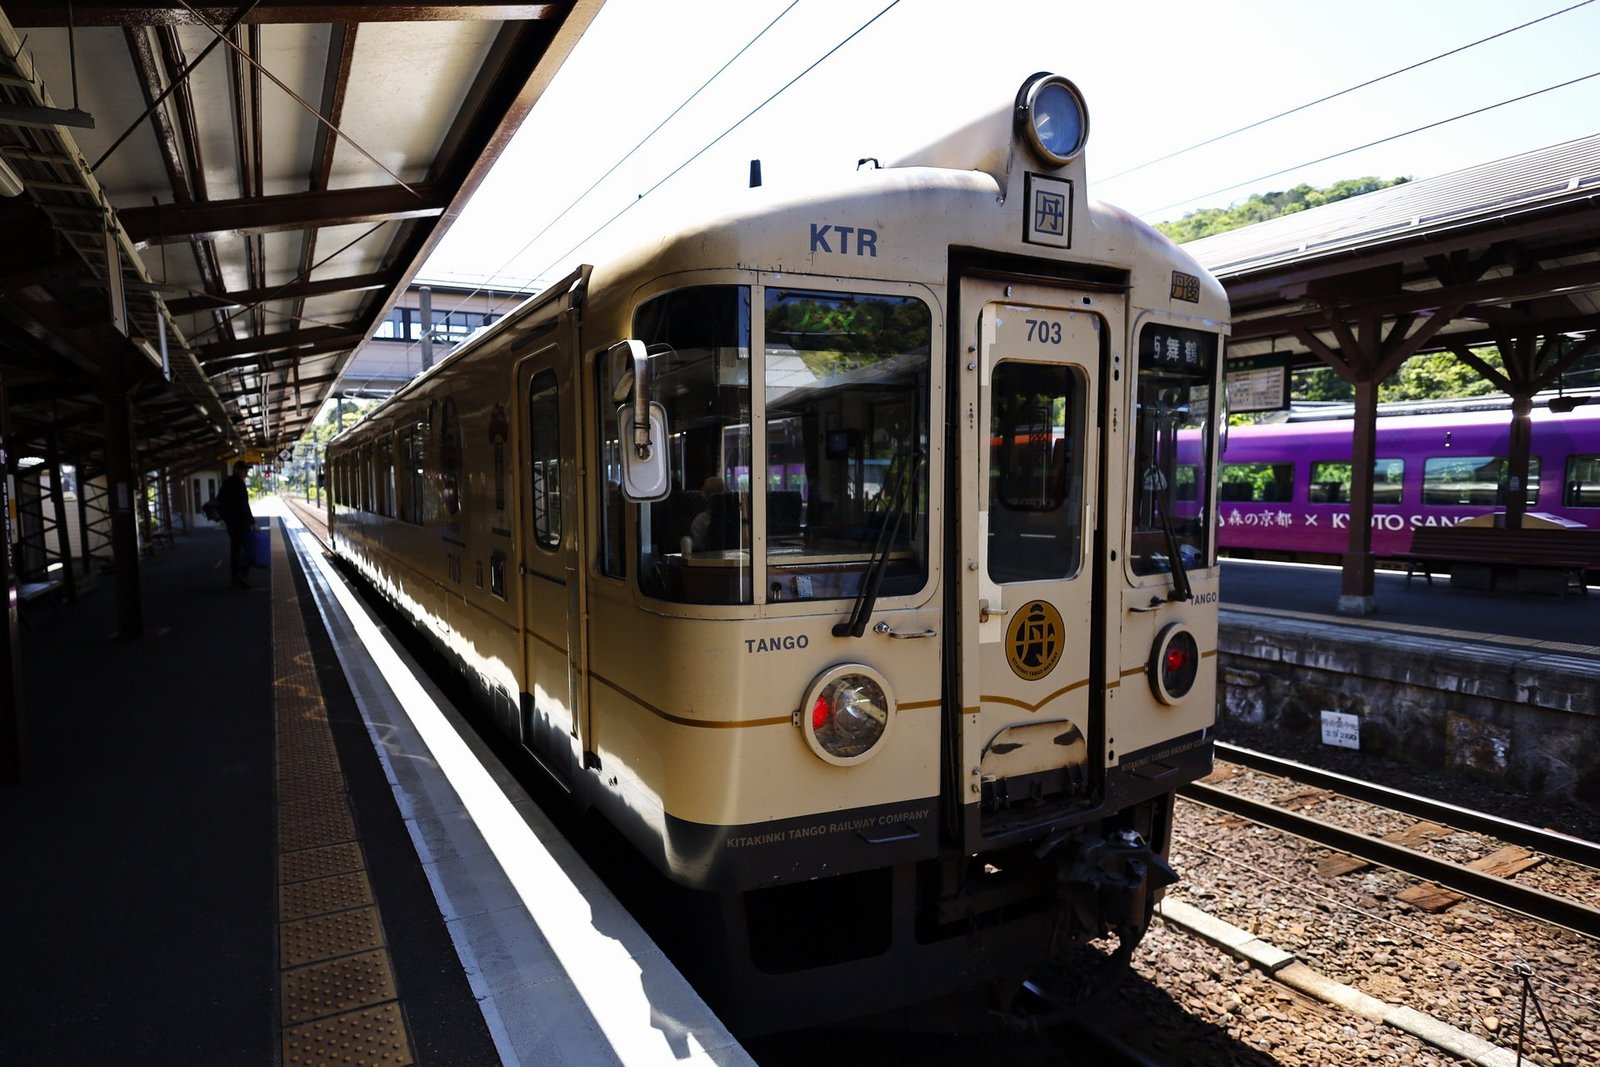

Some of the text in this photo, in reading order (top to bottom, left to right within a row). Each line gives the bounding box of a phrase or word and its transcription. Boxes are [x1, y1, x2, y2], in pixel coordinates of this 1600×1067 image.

[1036, 195, 1064, 231] 丹
[810, 223, 878, 257] KTR
[1172, 272, 1199, 303] 丹後
[1025, 319, 1062, 345] 703
[1332, 513, 1404, 531] KTO
[1190, 592, 1217, 607] TANGO
[744, 634, 809, 654] TANGO
[1121, 756, 1150, 772] KITAKINKI
[1151, 749, 1170, 761] TANGO
[1170, 743, 1193, 757] RAILWAY
[726, 809, 930, 848] KITAKINKI TANGO RAILWAY COMPANY
